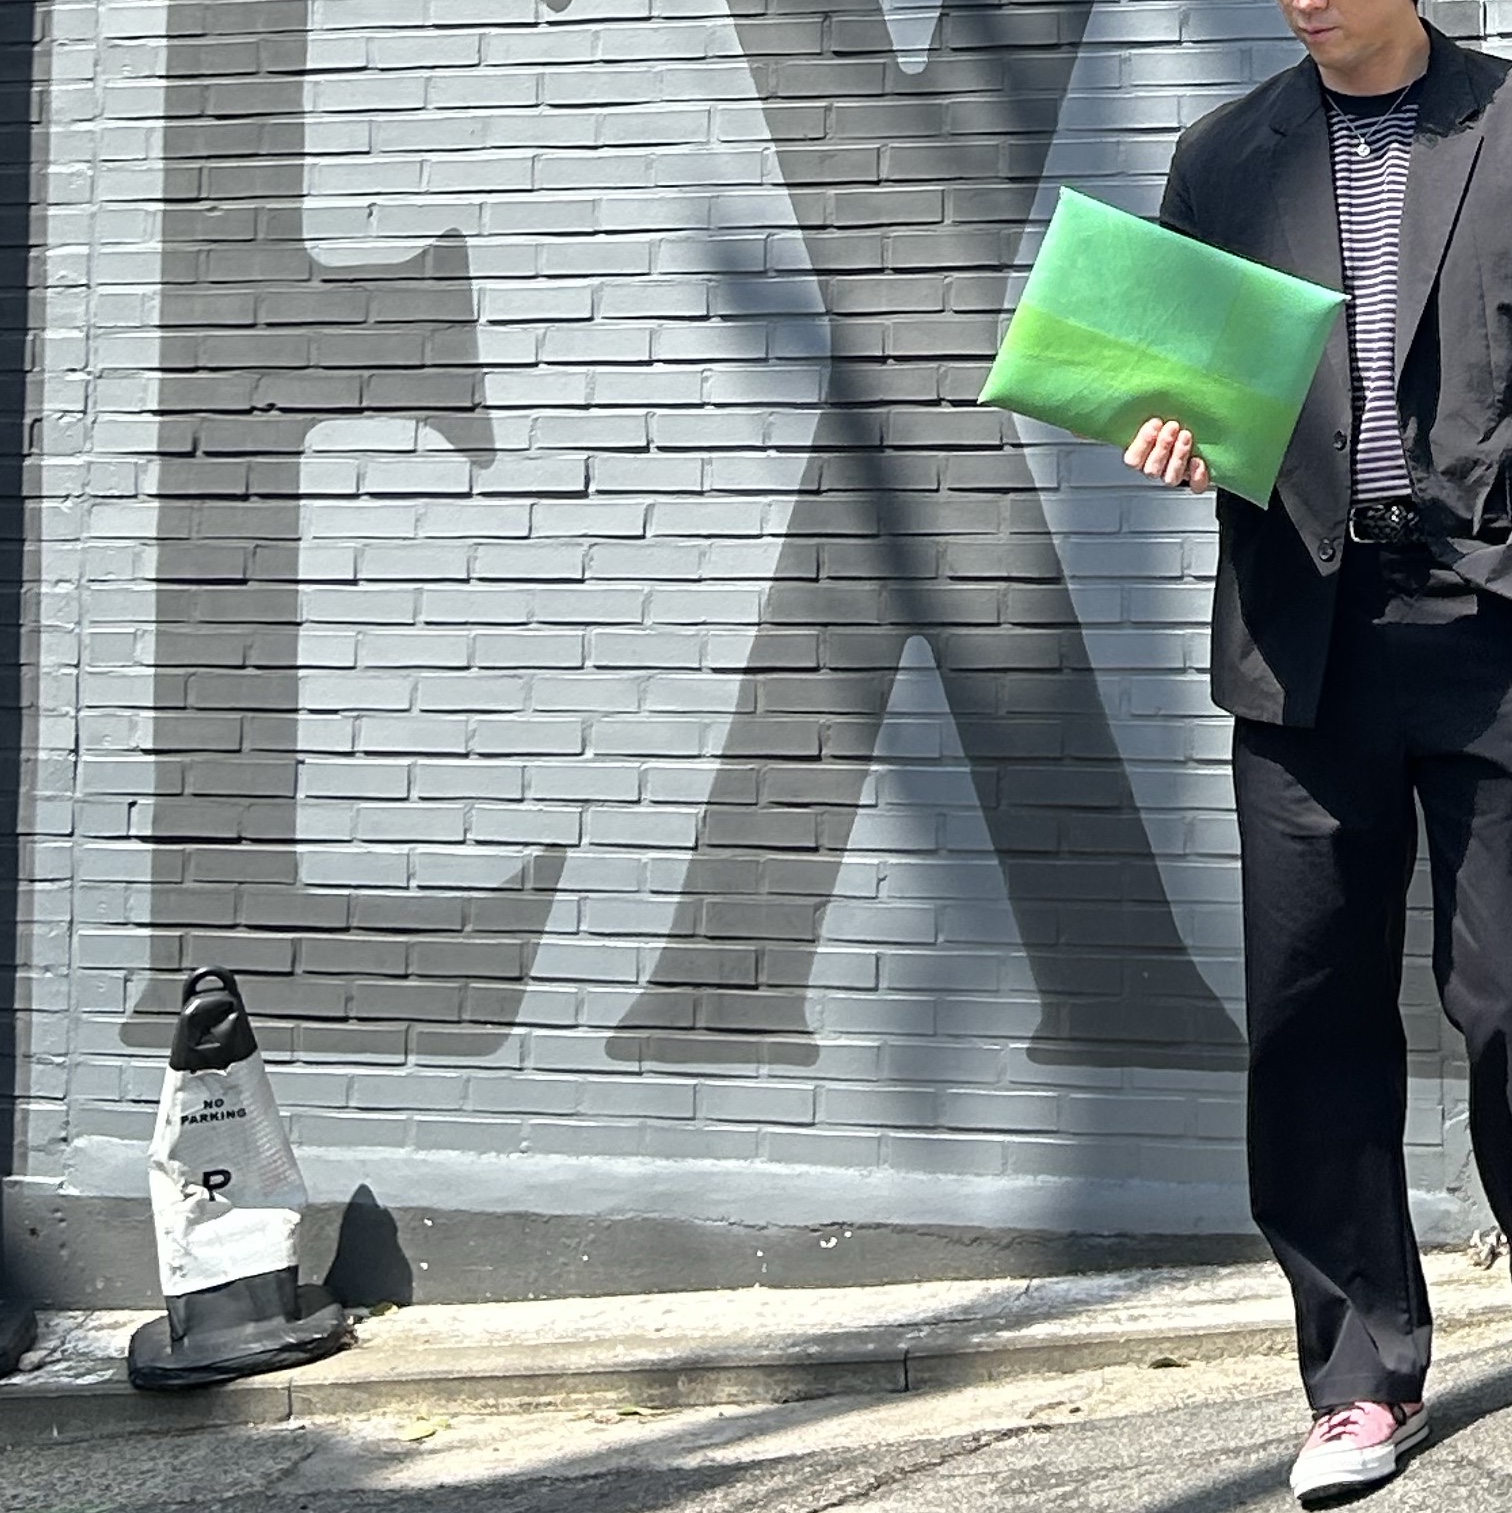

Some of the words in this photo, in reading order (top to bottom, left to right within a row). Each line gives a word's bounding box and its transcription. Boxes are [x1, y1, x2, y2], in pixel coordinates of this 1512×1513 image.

[203, 1098, 225, 1109] NO
[180, 1108, 247, 1126] PARKING
[202, 1169, 232, 1202] P
